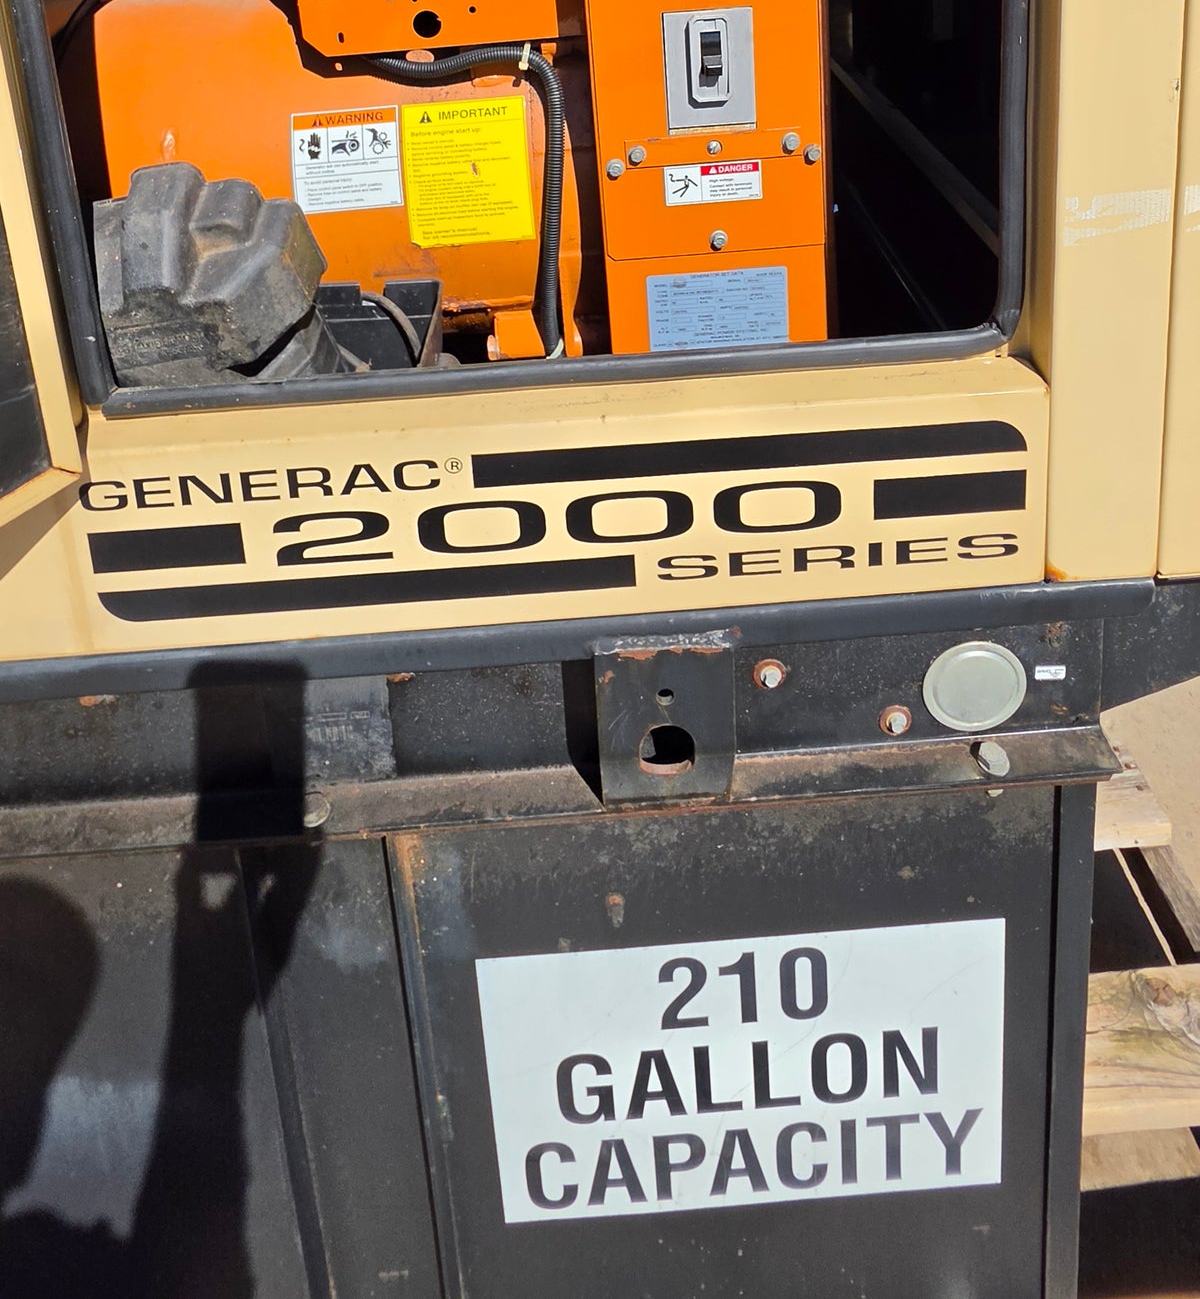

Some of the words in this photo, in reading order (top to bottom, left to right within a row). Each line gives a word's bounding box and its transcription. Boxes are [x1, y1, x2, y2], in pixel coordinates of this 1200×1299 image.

[325, 112, 384, 126] WARNING
[433, 129, 454, 137] engine
[438, 106, 508, 121] IMPORTANT
[718, 163, 753, 173] DANGER
[272, 479, 842, 566] 2000
[657, 532, 1019, 582] SERIES
[657, 946, 829, 1031] 210
[556, 1026, 939, 1125] GALLON
[524, 1107, 984, 1210] CAPACITY
